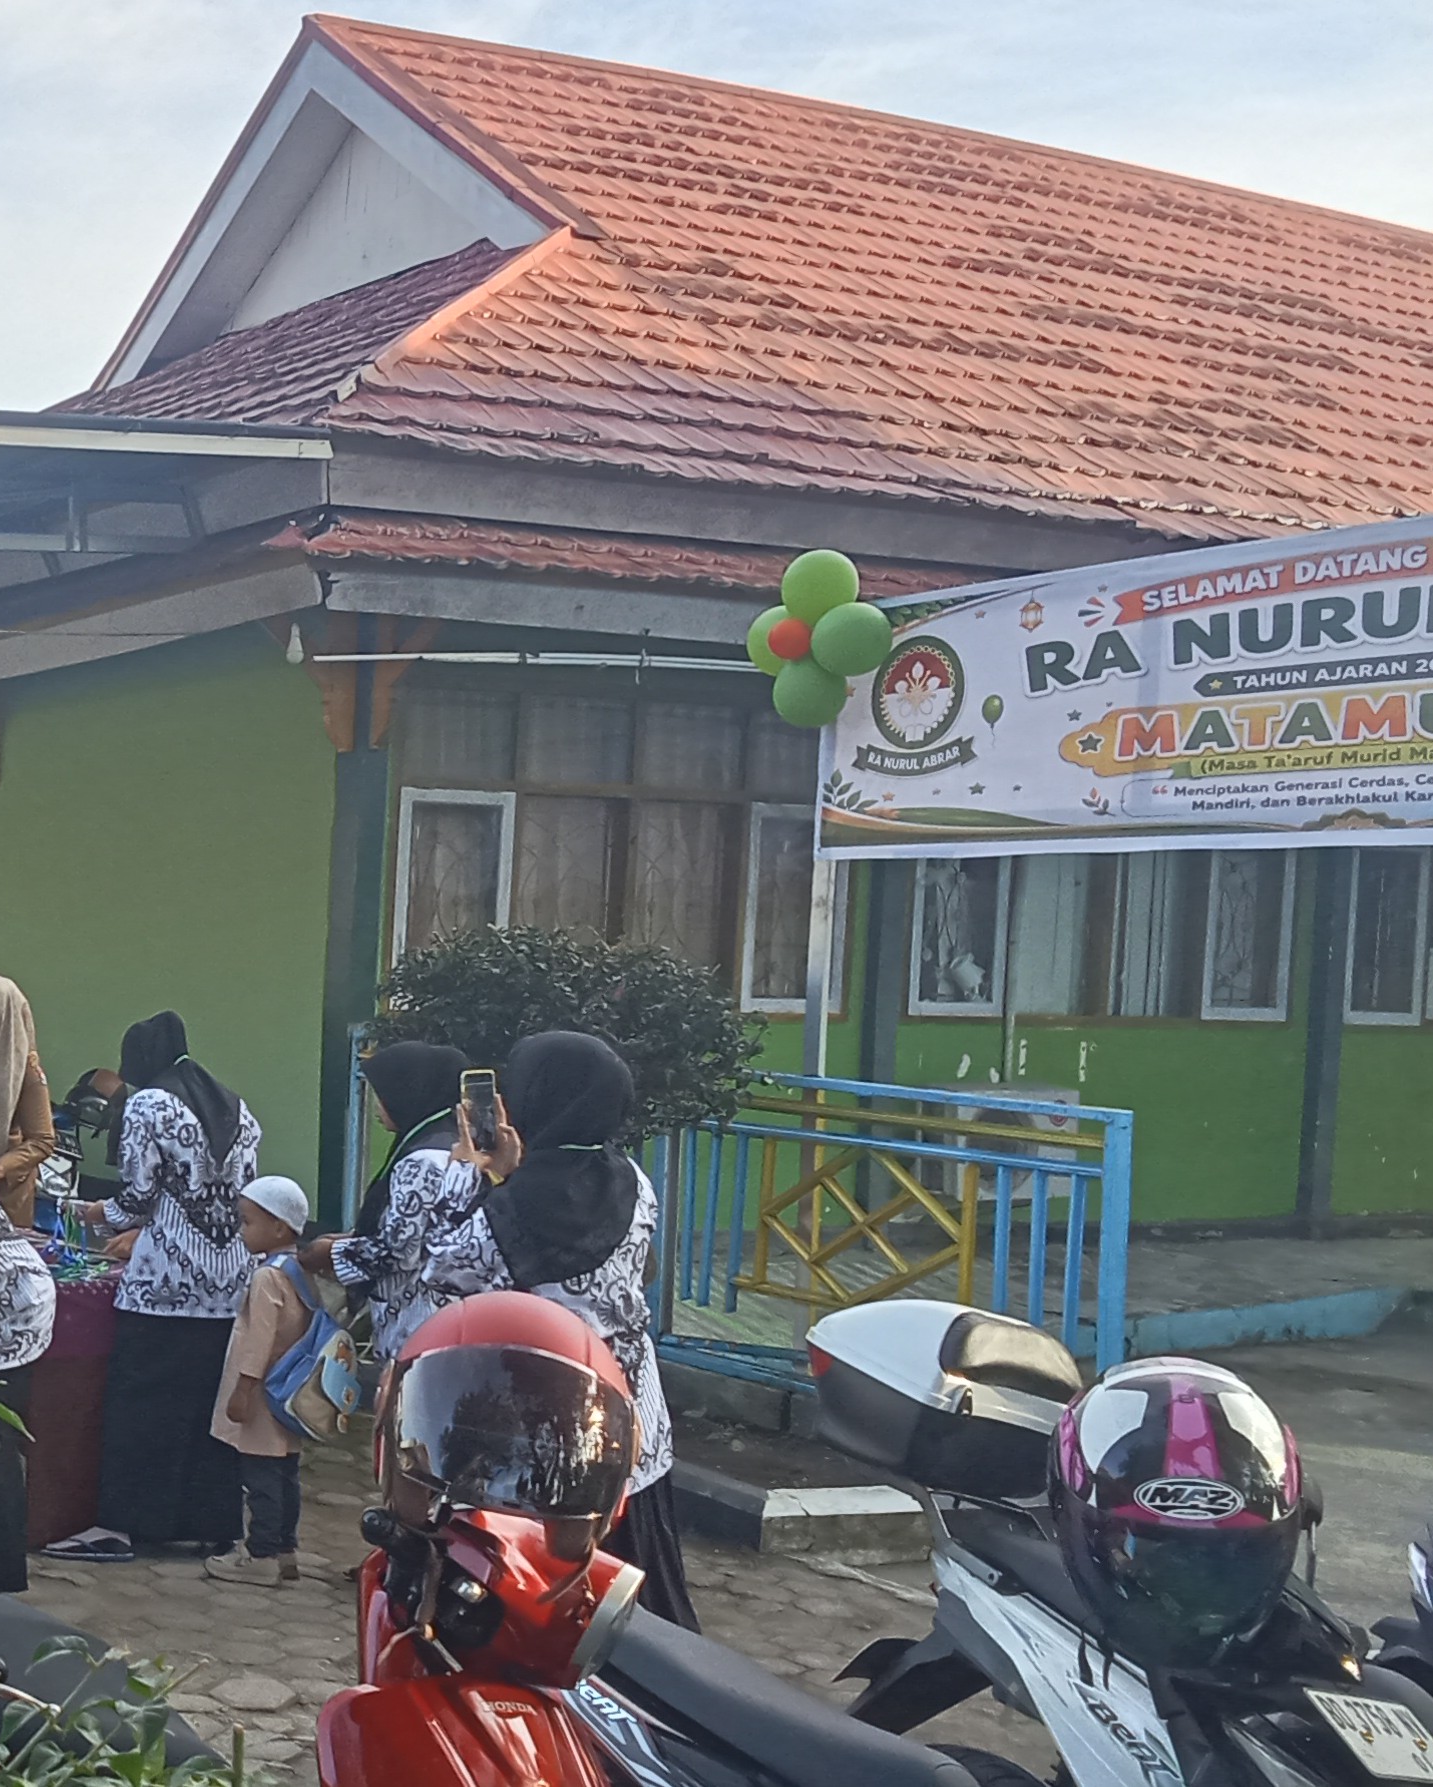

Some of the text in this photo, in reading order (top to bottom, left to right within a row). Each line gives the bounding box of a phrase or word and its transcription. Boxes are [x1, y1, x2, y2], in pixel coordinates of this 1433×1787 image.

[1142, 546, 1428, 612] SELAMAT DATANG
[1025, 586, 1433, 693] RA NURU
[1233, 670, 1307, 690] TAHUN
[1314, 661, 1408, 682] AJARAN
[1117, 693, 1433, 757] MATAM
[868, 746, 961, 770] RA NURUL ABRAR
[1200, 757, 1258, 776] (Masa
[1264, 750, 1334, 769] Ta'aruf
[1341, 747, 1401, 765] Murid
[1174, 783, 1269, 798] Menciptakan
[1275, 777, 1343, 793] Generasi
[1348, 775, 1410, 789] Cerdas,
[1192, 799, 1256, 812] Mandiri,
[1260, 797, 1290, 808] dan
[1297, 792, 1399, 807] Berakhlakul
[481, 1701, 538, 1717] HONDA
